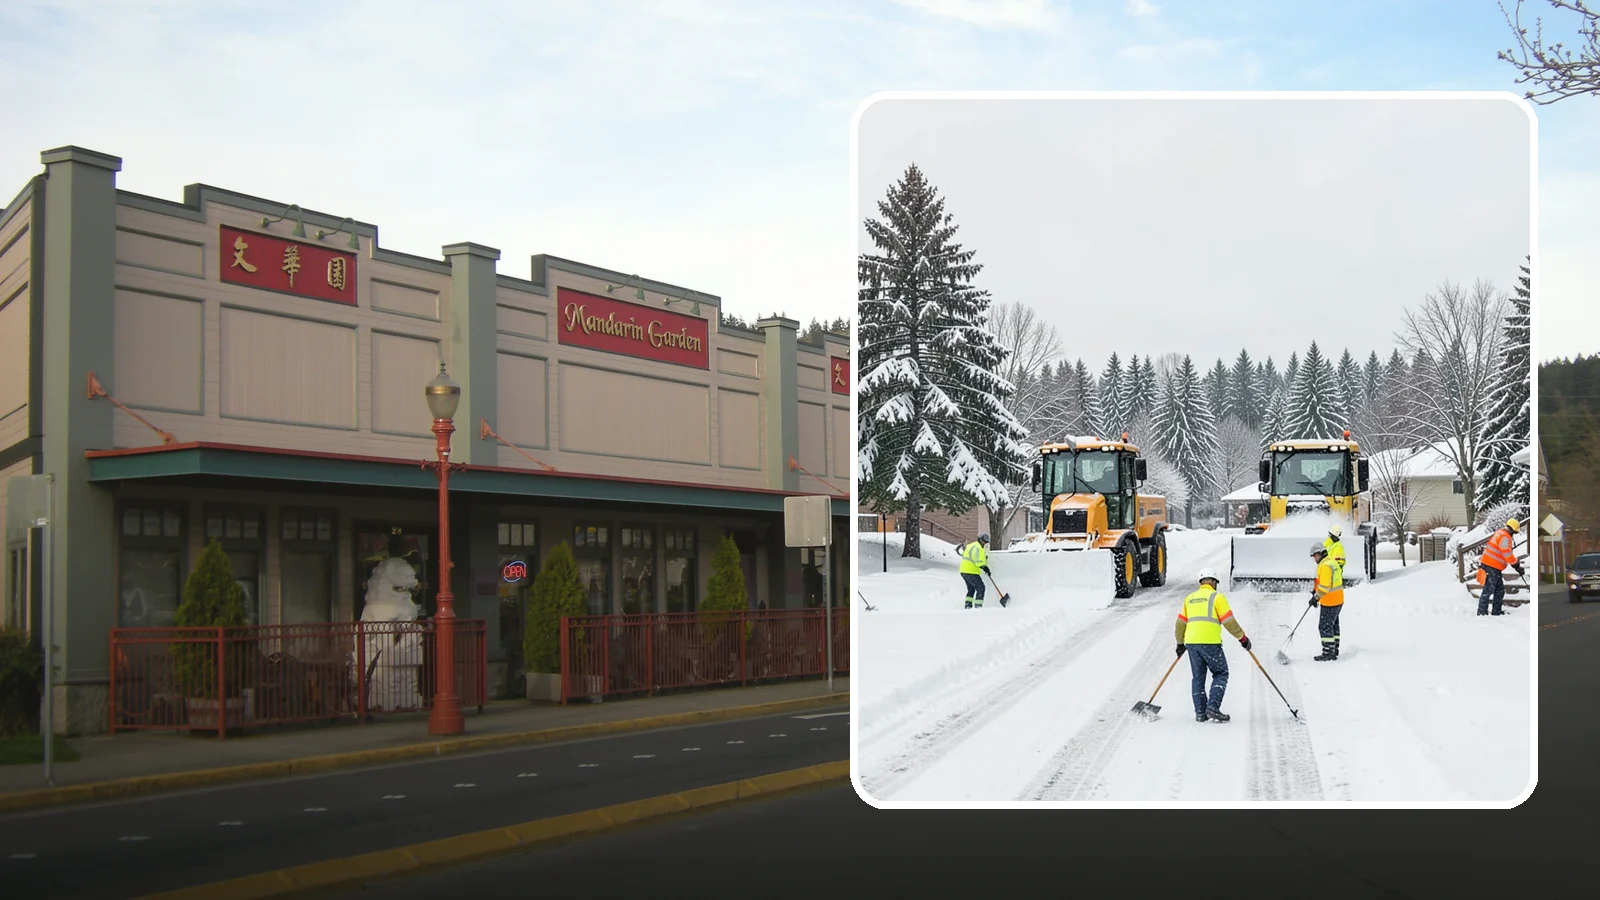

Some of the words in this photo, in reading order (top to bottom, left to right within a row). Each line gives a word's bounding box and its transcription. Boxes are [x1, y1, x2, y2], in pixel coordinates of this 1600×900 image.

[231, 236, 346, 291] 文華園
[564, 302, 644, 341] Mandarin
[648, 320, 702, 352] Garden
[834, 363, 846, 386] 文
[503, 565, 527, 578] OPEN
